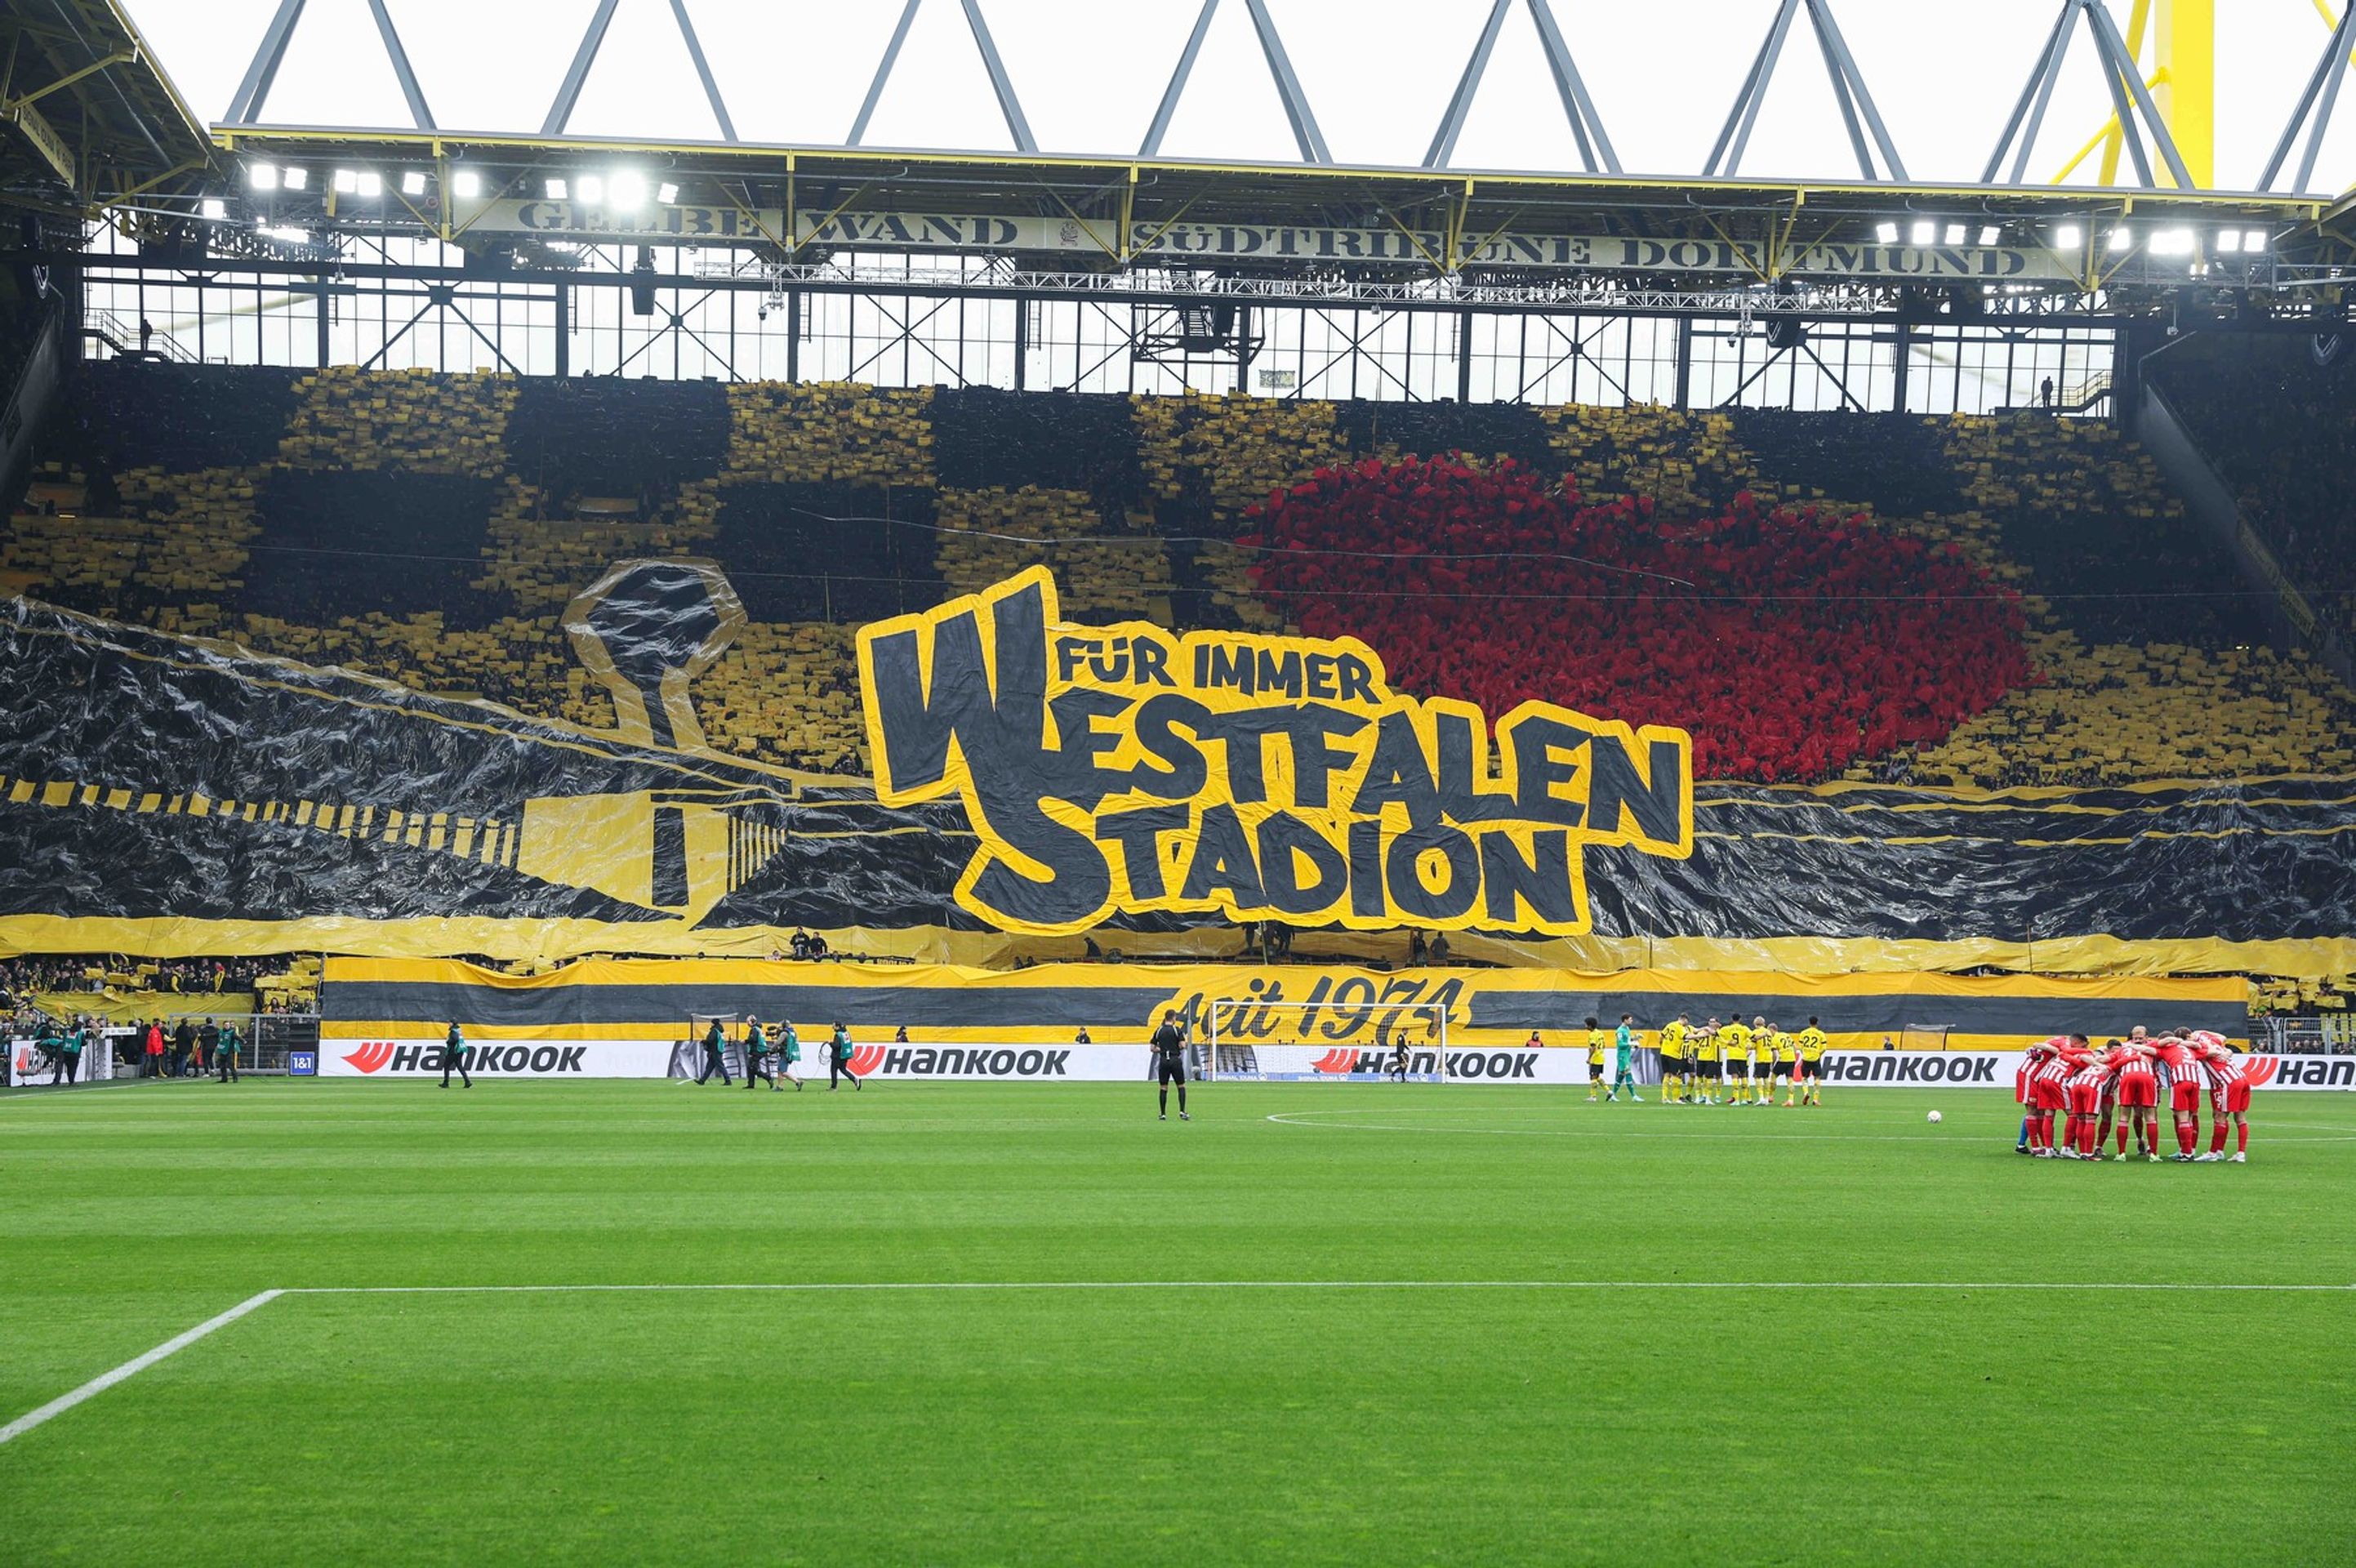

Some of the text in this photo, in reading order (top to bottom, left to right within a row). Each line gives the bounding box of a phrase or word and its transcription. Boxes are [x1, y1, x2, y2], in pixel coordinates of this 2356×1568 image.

[805, 213, 1018, 244] WAND
[1620, 238, 2024, 275] DORTMUND
[1055, 635, 1382, 704] FÜR IMMER
[871, 581, 1681, 844] WESTFALEN
[970, 794, 1578, 924] STADION
[1297, 975, 1465, 1045] 1974
[1803, 1035, 1818, 1048] 22
[293, 1057, 311, 1070] 1&1
